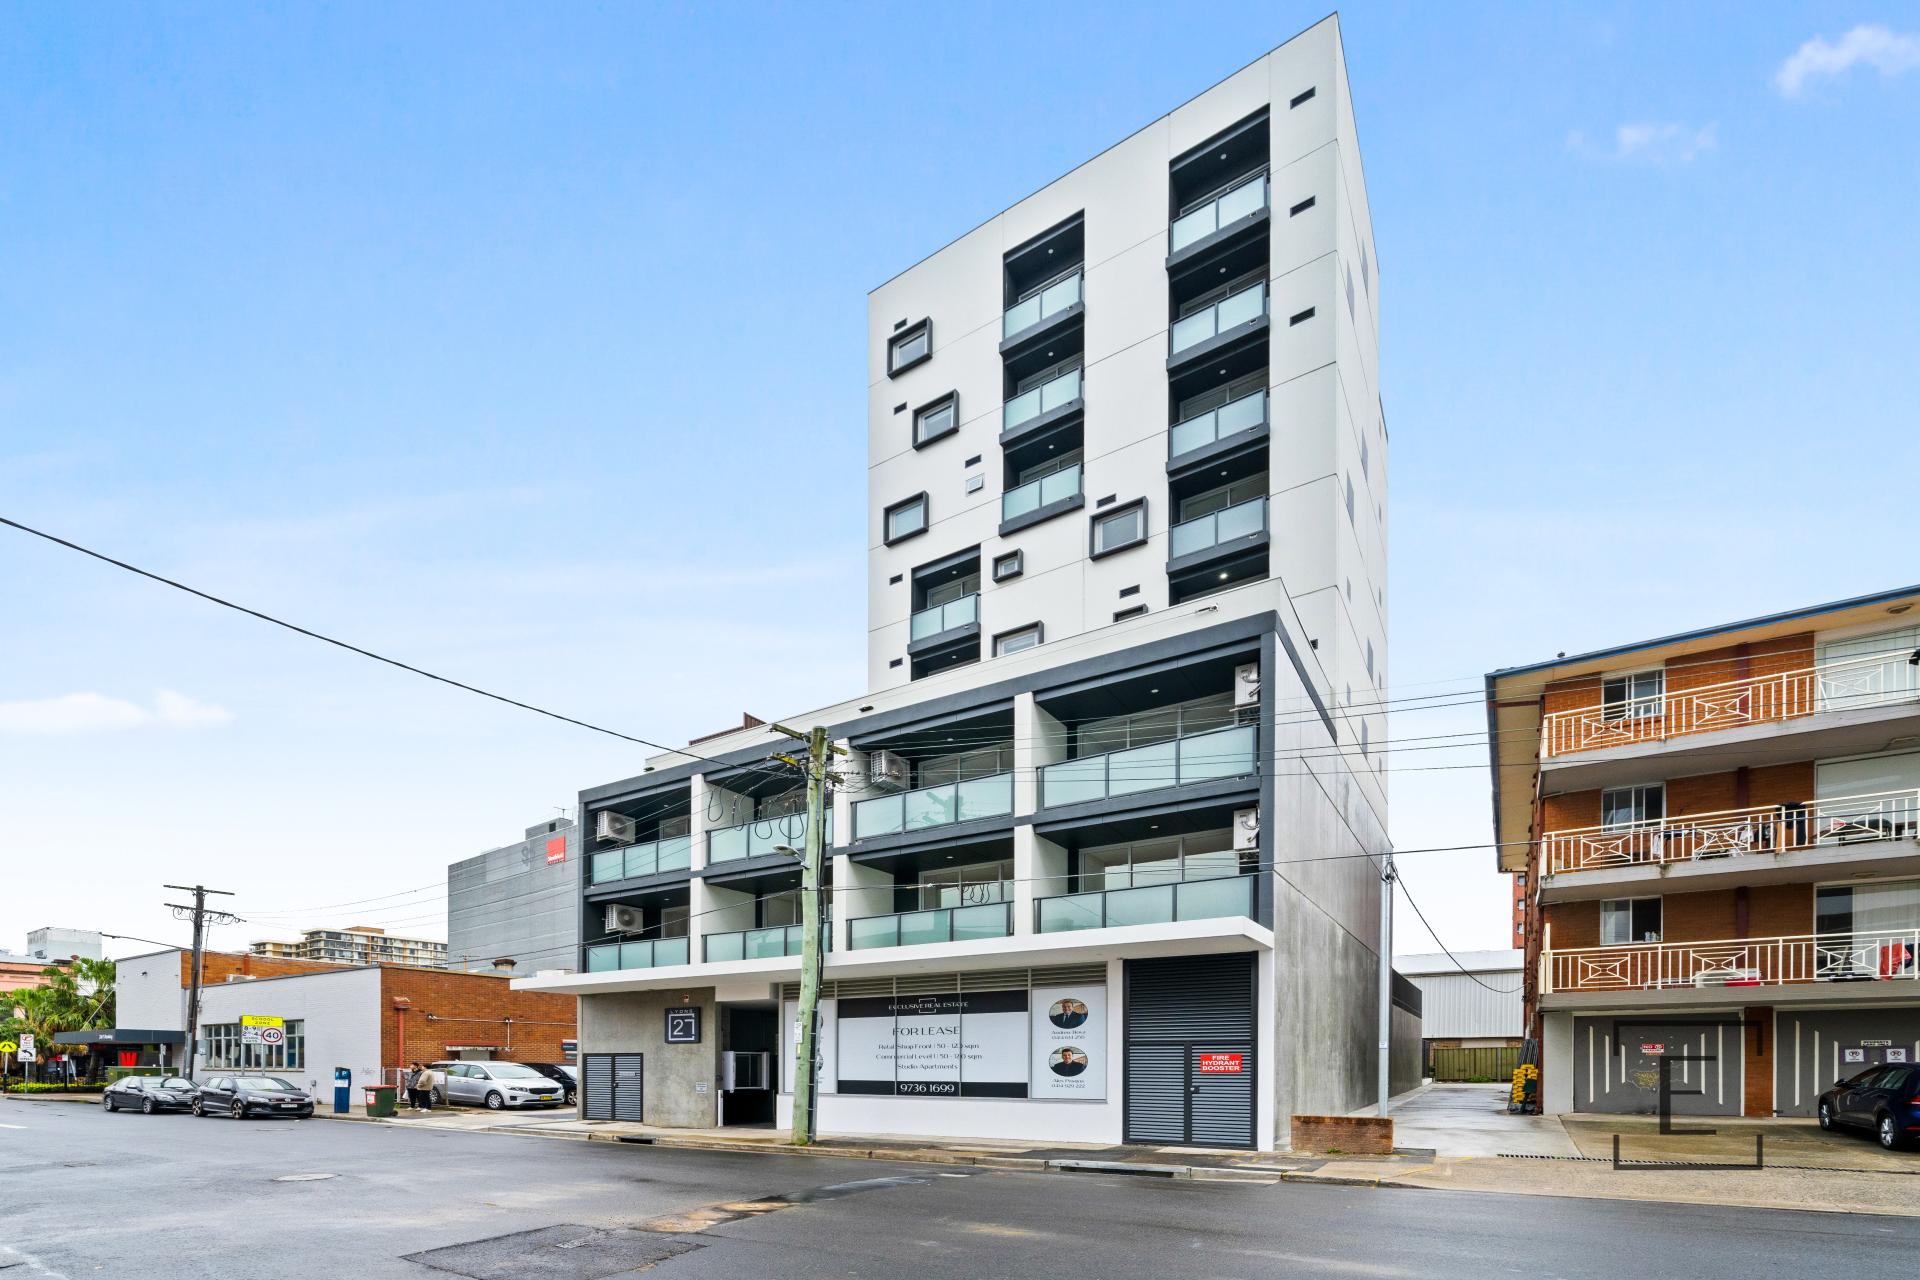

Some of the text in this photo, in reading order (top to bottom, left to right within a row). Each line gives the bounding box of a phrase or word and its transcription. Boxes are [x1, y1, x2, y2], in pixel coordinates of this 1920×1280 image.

[673, 1019, 694, 1034] 27
[892, 1026, 960, 1036] FOR LEASE
[900, 1084, 954, 1092] 9736 1699
